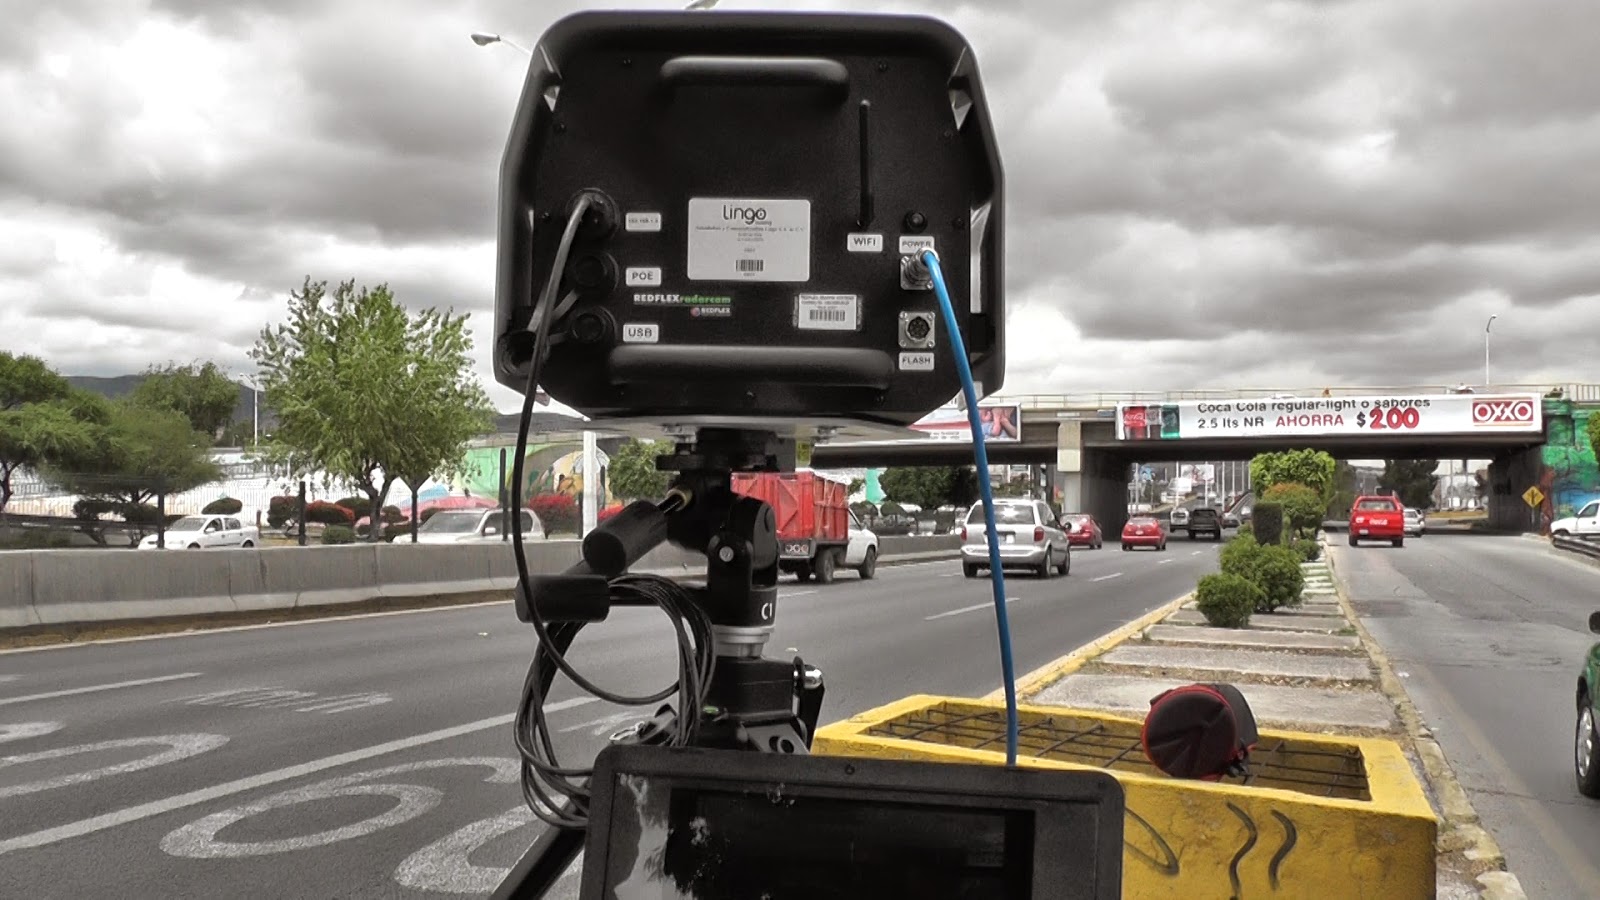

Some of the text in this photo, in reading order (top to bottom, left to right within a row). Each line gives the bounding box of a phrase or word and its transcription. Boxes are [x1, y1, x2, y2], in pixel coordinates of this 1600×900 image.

[723, 204, 767, 225] lingo
[853, 238, 876, 247] WIFI
[902, 240, 932, 249] POWER
[631, 271, 654, 281] POE
[628, 328, 653, 338] USB
[902, 356, 931, 366] FLASH
[1197, 401, 1232, 413] Coca
[1236, 400, 1267, 412] Cola
[1361, 399, 1370, 409] o
[1374, 397, 1431, 409] sabores
[1474, 401, 1533, 420] OXXO
[1197, 417, 1218, 429] 2.5
[1243, 416, 1265, 428] NR
[1275, 413, 1345, 428] AHORRA
